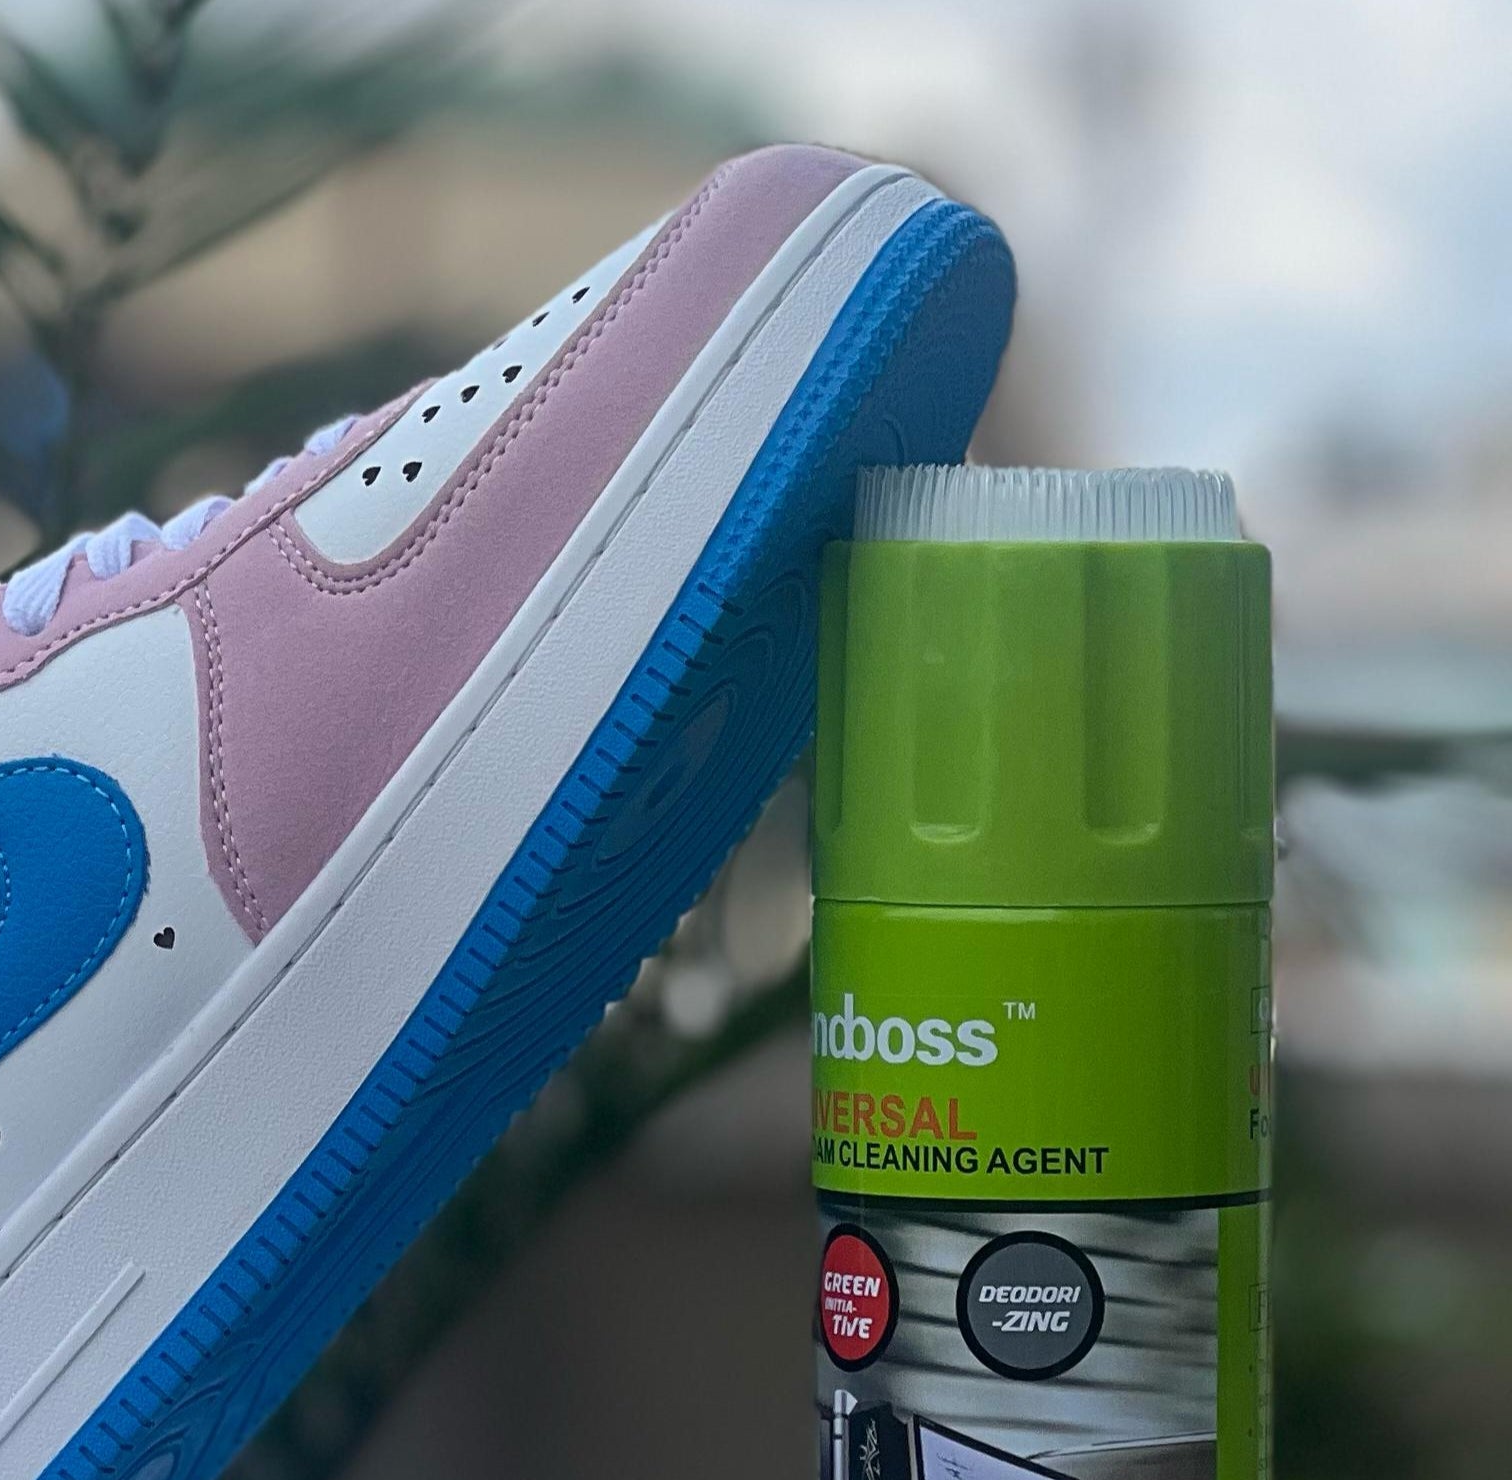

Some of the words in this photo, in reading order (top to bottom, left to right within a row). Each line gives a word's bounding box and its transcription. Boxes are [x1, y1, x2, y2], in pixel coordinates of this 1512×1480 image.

[1003, 1002, 1036, 1020] TM
[838, 1139, 979, 1174] CLEANING
[987, 1147, 1110, 1175] AGENT
[824, 1271, 882, 1298] GREEN
[978, 1285, 1081, 1304] DEODORI
[832, 1314, 873, 1339] TIVE
[992, 1310, 1070, 1333] -ZING
